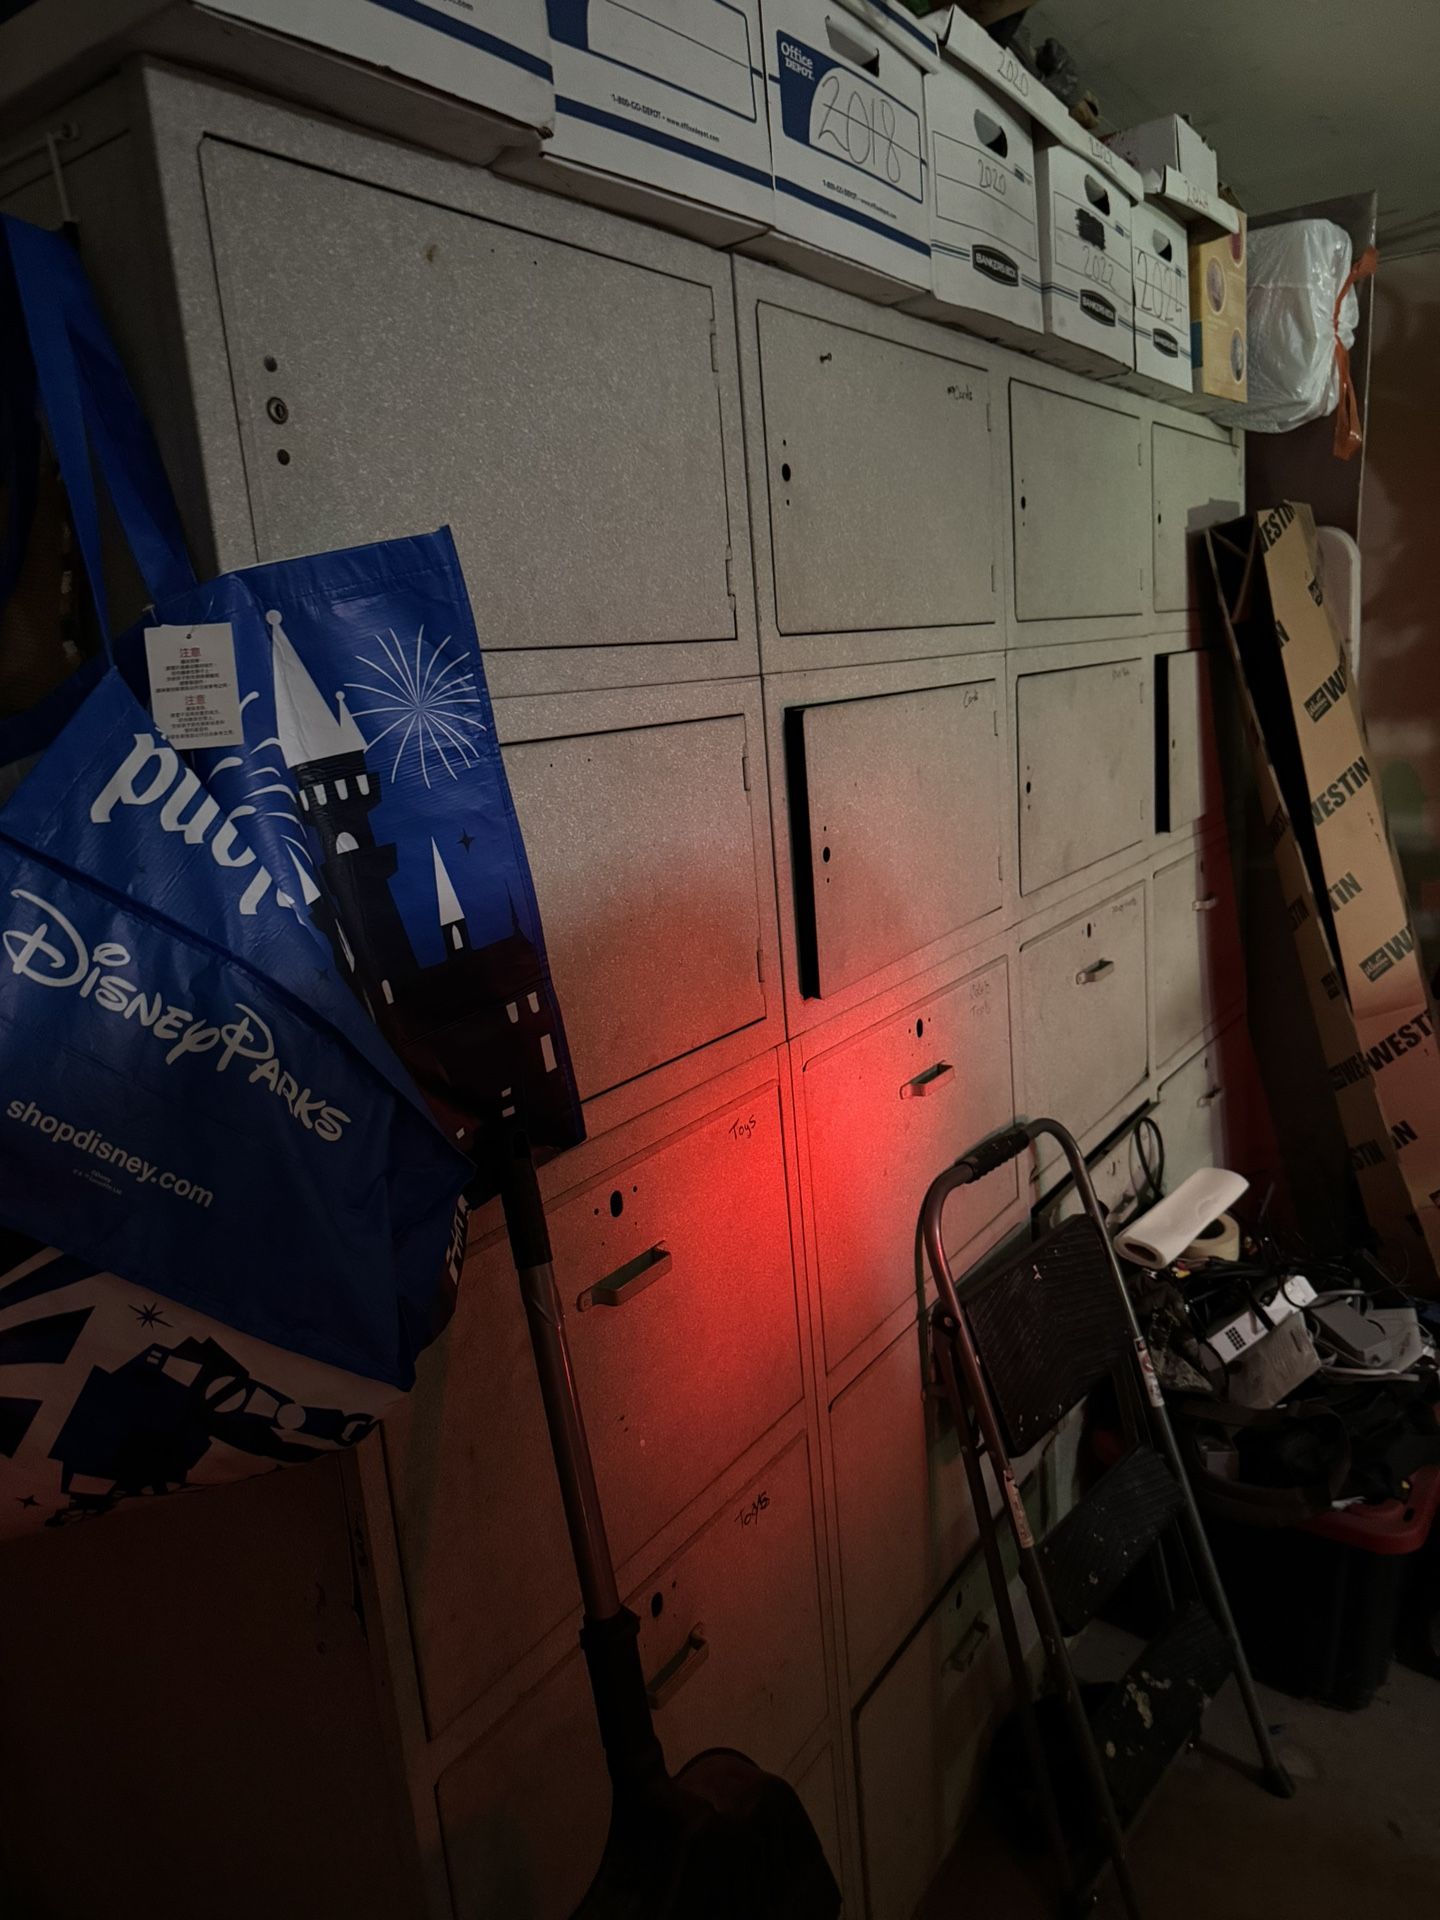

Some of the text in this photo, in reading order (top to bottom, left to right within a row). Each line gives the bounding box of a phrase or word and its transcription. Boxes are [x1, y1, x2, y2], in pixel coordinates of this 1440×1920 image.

[780, 41, 814, 70] Office
[785, 57, 815, 80] DEPOT
[818, 75, 901, 183] 2018
[728, 1114, 757, 1140] Toys
[6, 1099, 215, 1208] shopdisney.com
